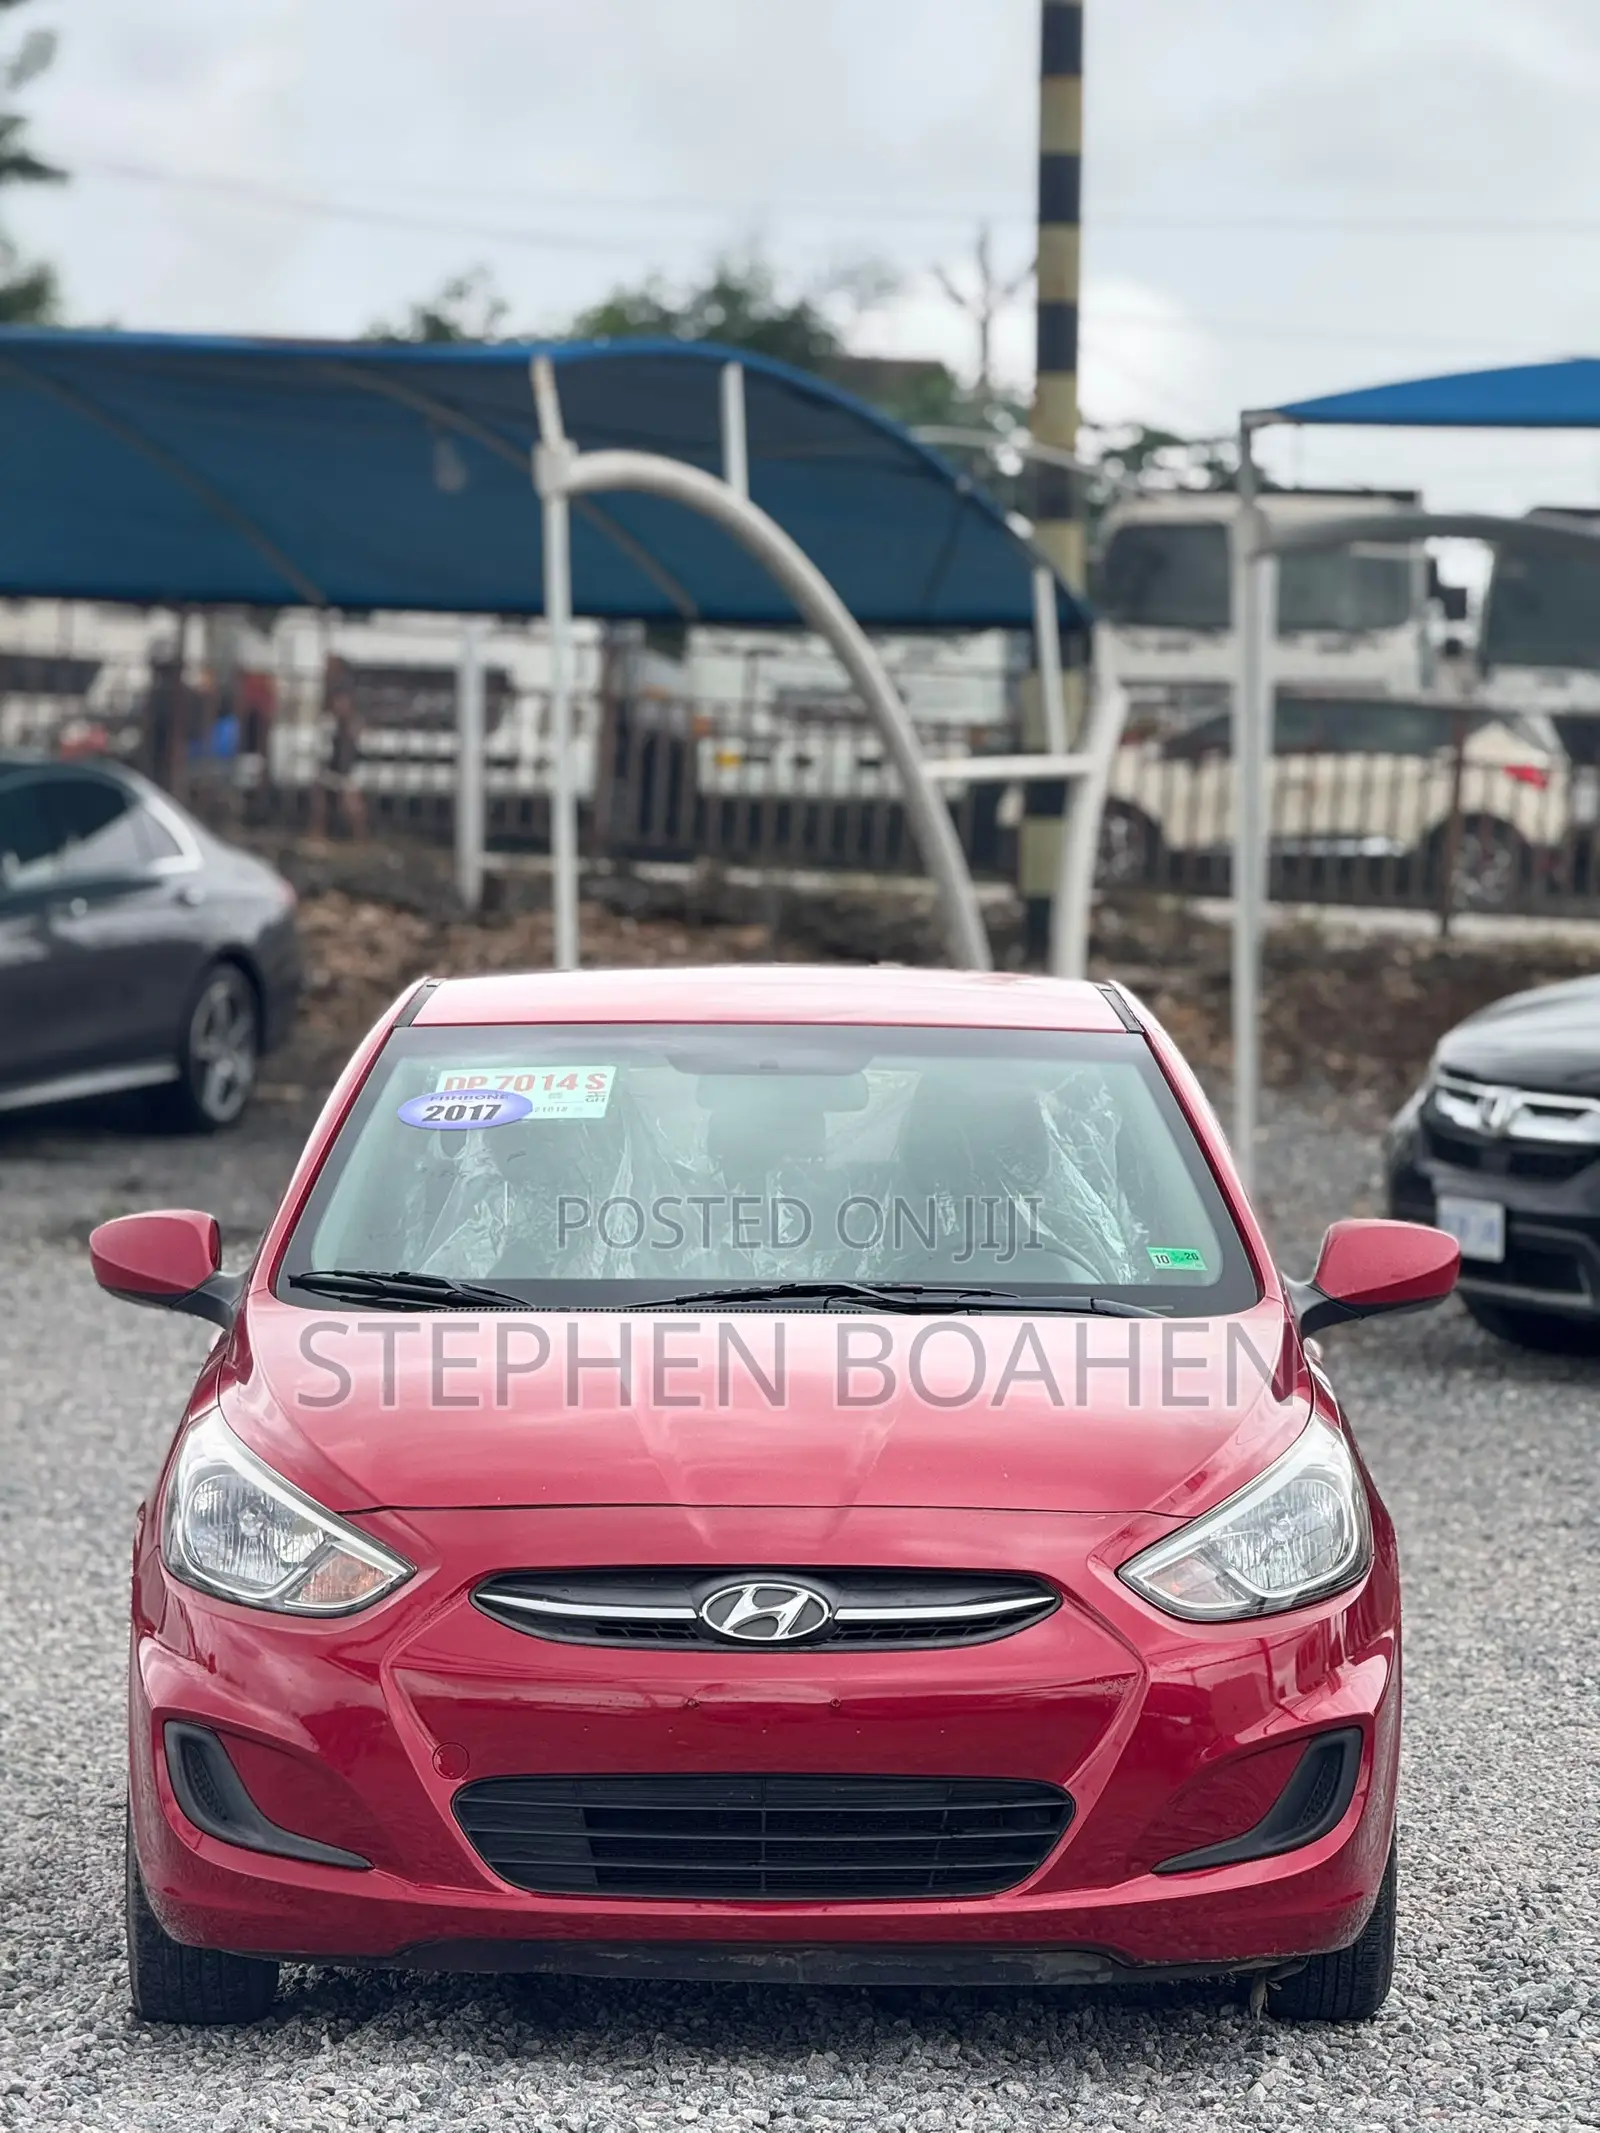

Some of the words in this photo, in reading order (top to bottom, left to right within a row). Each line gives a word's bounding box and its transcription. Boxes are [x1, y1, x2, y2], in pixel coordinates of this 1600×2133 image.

[585, 1072, 607, 1090] S
[422, 1104, 502, 1122] 2017
[1154, 1254, 1170, 1264] 10
